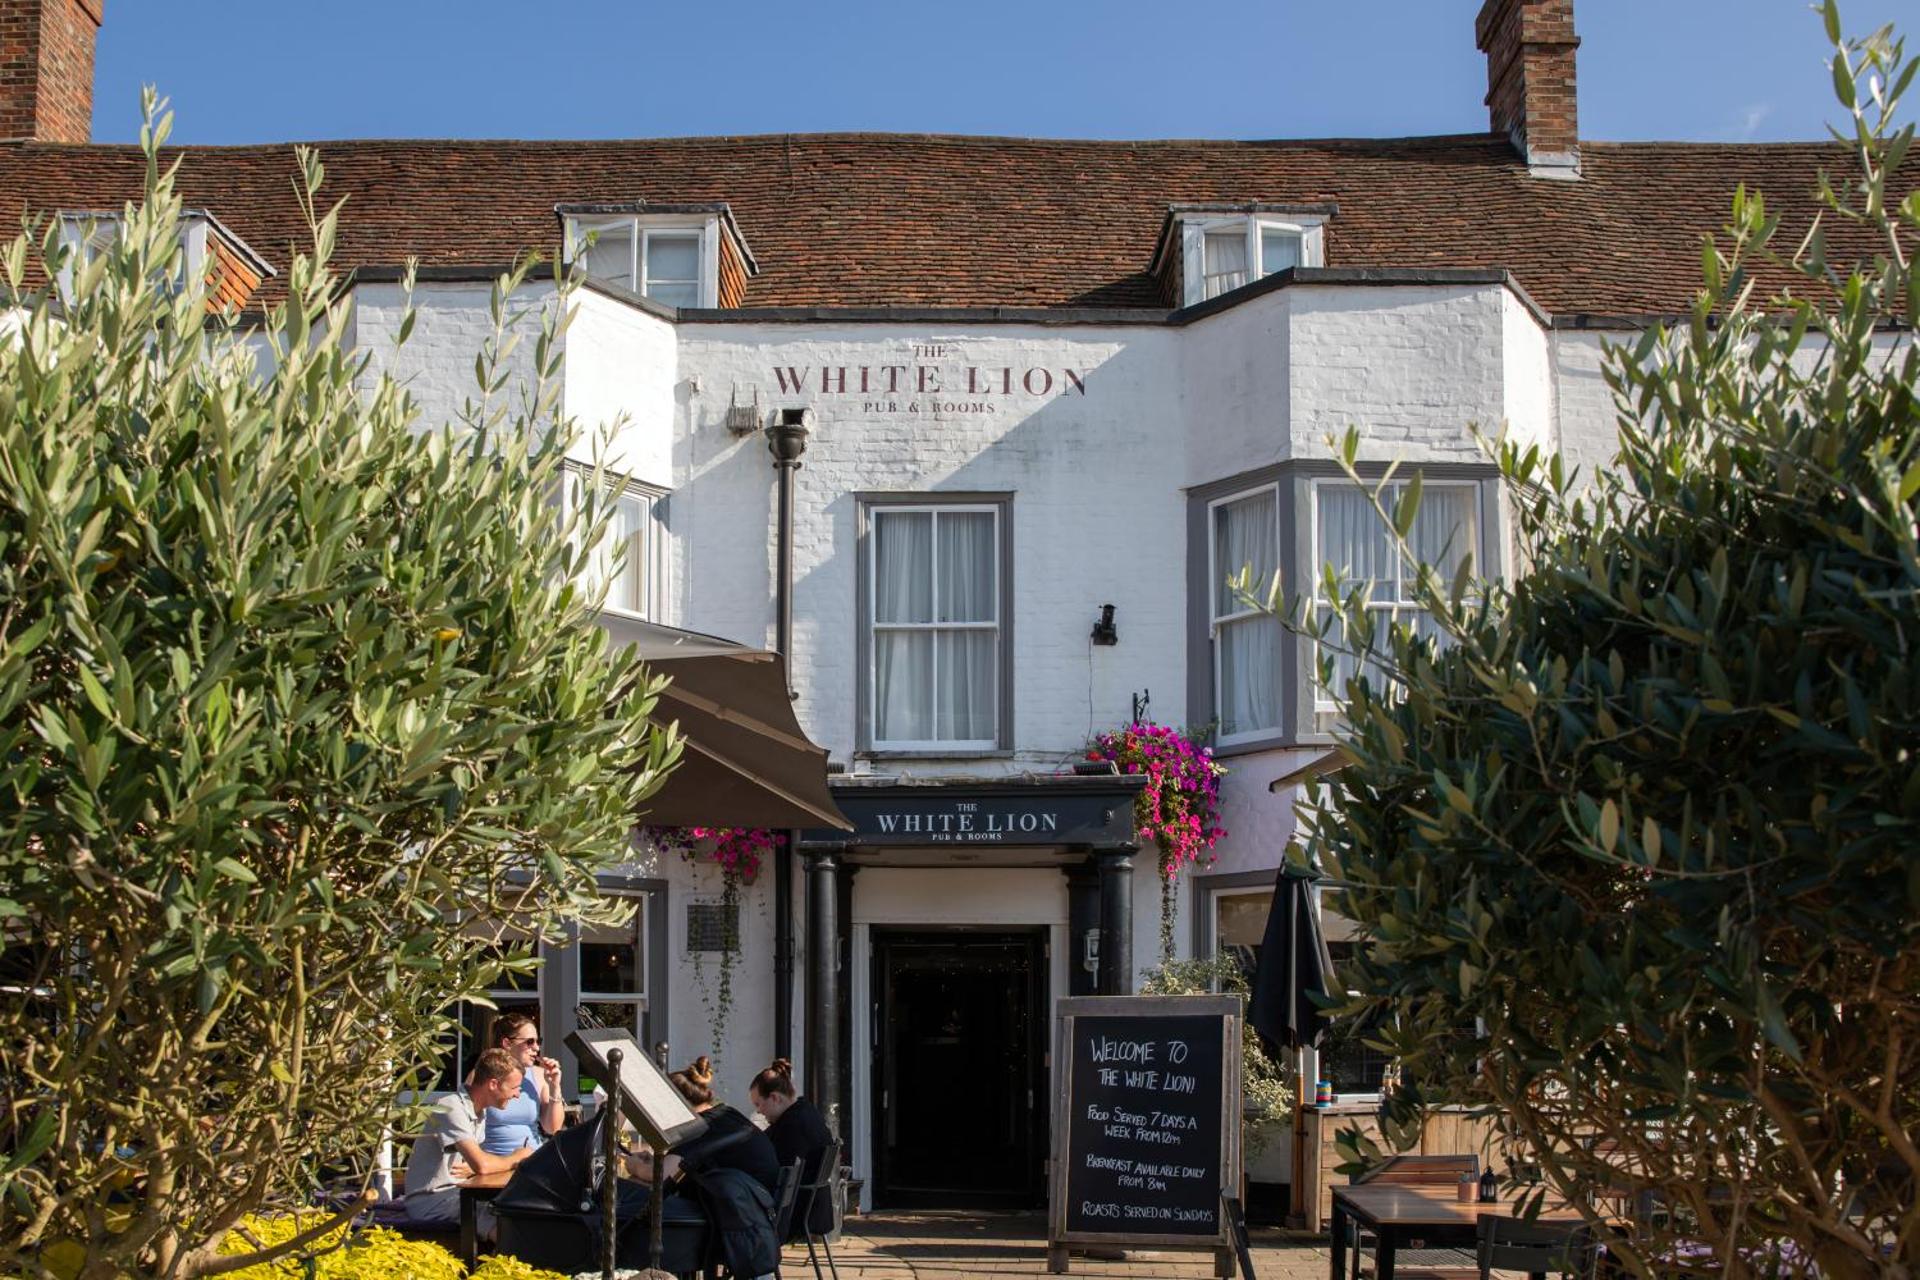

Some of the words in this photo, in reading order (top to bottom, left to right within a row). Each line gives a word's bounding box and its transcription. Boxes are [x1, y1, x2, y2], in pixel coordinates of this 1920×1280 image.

[911, 344, 948, 358] THE
[771, 365, 942, 396] WHITE
[967, 366, 1097, 397] LION
[863, 402, 898, 413] PUB
[908, 402, 920, 413] &
[932, 401, 996, 413] ROOMS
[956, 803, 978, 812] THE
[875, 813, 975, 833] WHITE
[985, 813, 1058, 832] LION
[932, 833, 951, 841] PUB
[968, 832, 1002, 841] ROOMS
[1090, 1035, 1156, 1064] WELCOME
[1167, 1040, 1188, 1064] TO
[1098, 1068, 1119, 1087] THE
[1125, 1070, 1160, 1090] WHITE
[1163, 1072, 1195, 1094] LION!
[1151, 1111, 1161, 1126] 7
[1160, 1114, 1186, 1129] DAYS
[1187, 1116, 1198, 1130] A
[1104, 1124, 1131, 1138] WEEK
[1136, 1127, 1160, 1143] FROM
[1134, 1162, 1180, 1177] AVAILABLE
[1182, 1166, 1206, 1178] DAILY
[1118, 1175, 1144, 1188] FROM
[1082, 1200, 1120, 1218] ROASTS
[1124, 1204, 1158, 1218] SERVED
[1159, 1207, 1172, 1218] ON
[1174, 1207, 1213, 1222] SUNDAYS
